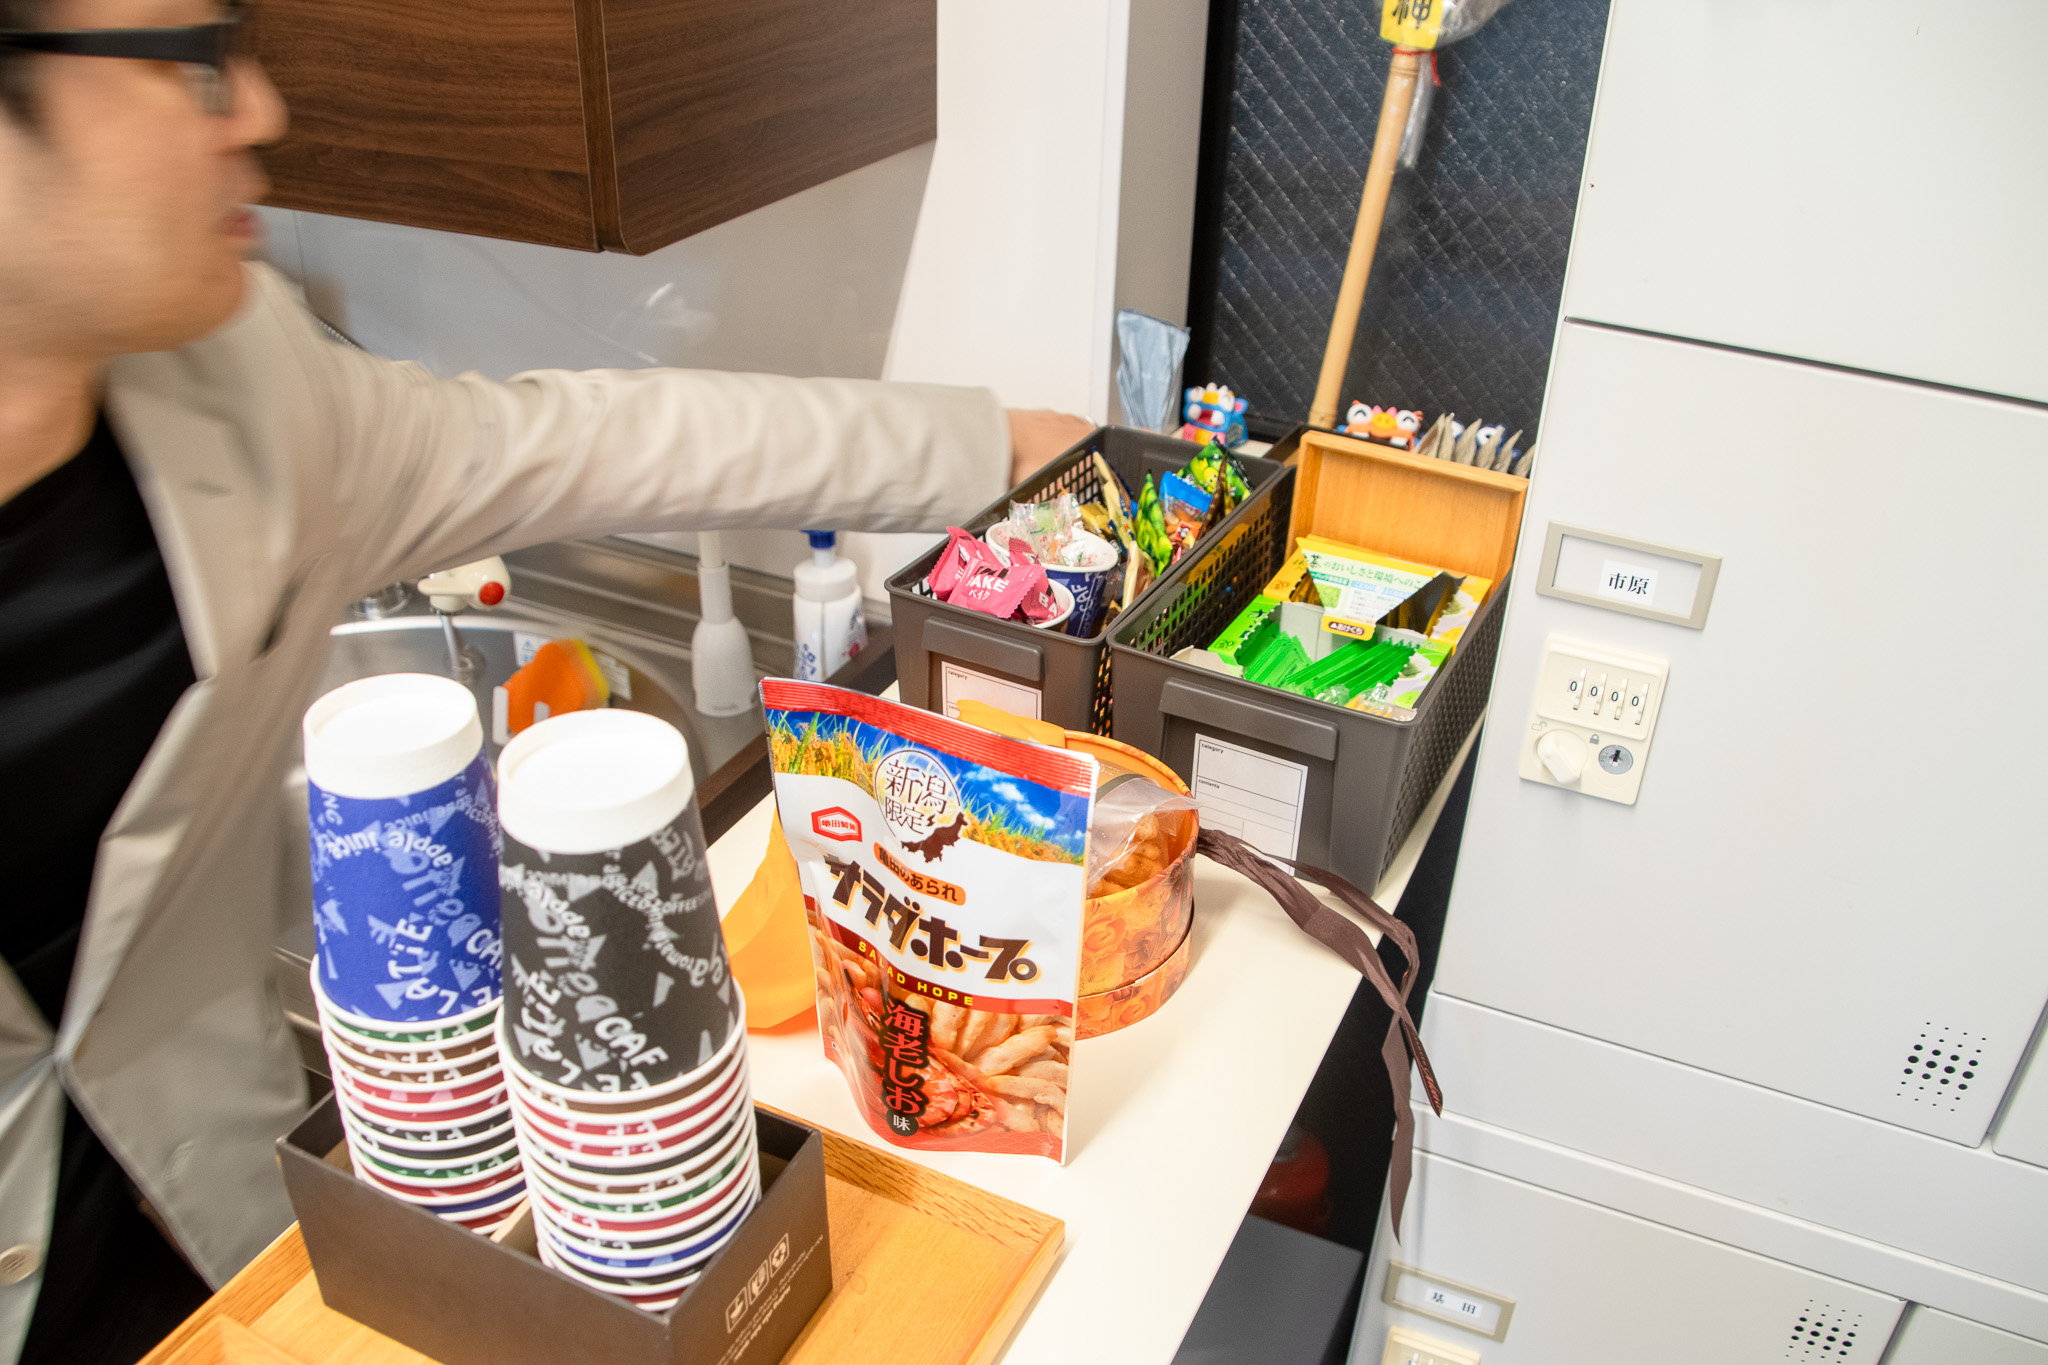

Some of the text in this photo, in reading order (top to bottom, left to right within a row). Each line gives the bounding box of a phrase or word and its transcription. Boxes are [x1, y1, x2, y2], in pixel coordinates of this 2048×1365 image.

[1607, 572, 1650, 595] 市原
[1201, 743, 1224, 754] category
[885, 759, 947, 815] 新潟
[885, 796, 925, 835] 限定
[388, 831, 453, 868] apple
[878, 847, 958, 902] 亀田のあられ
[824, 853, 1038, 982] サラダホープ
[858, 940, 974, 1006] SALAD HOPE
